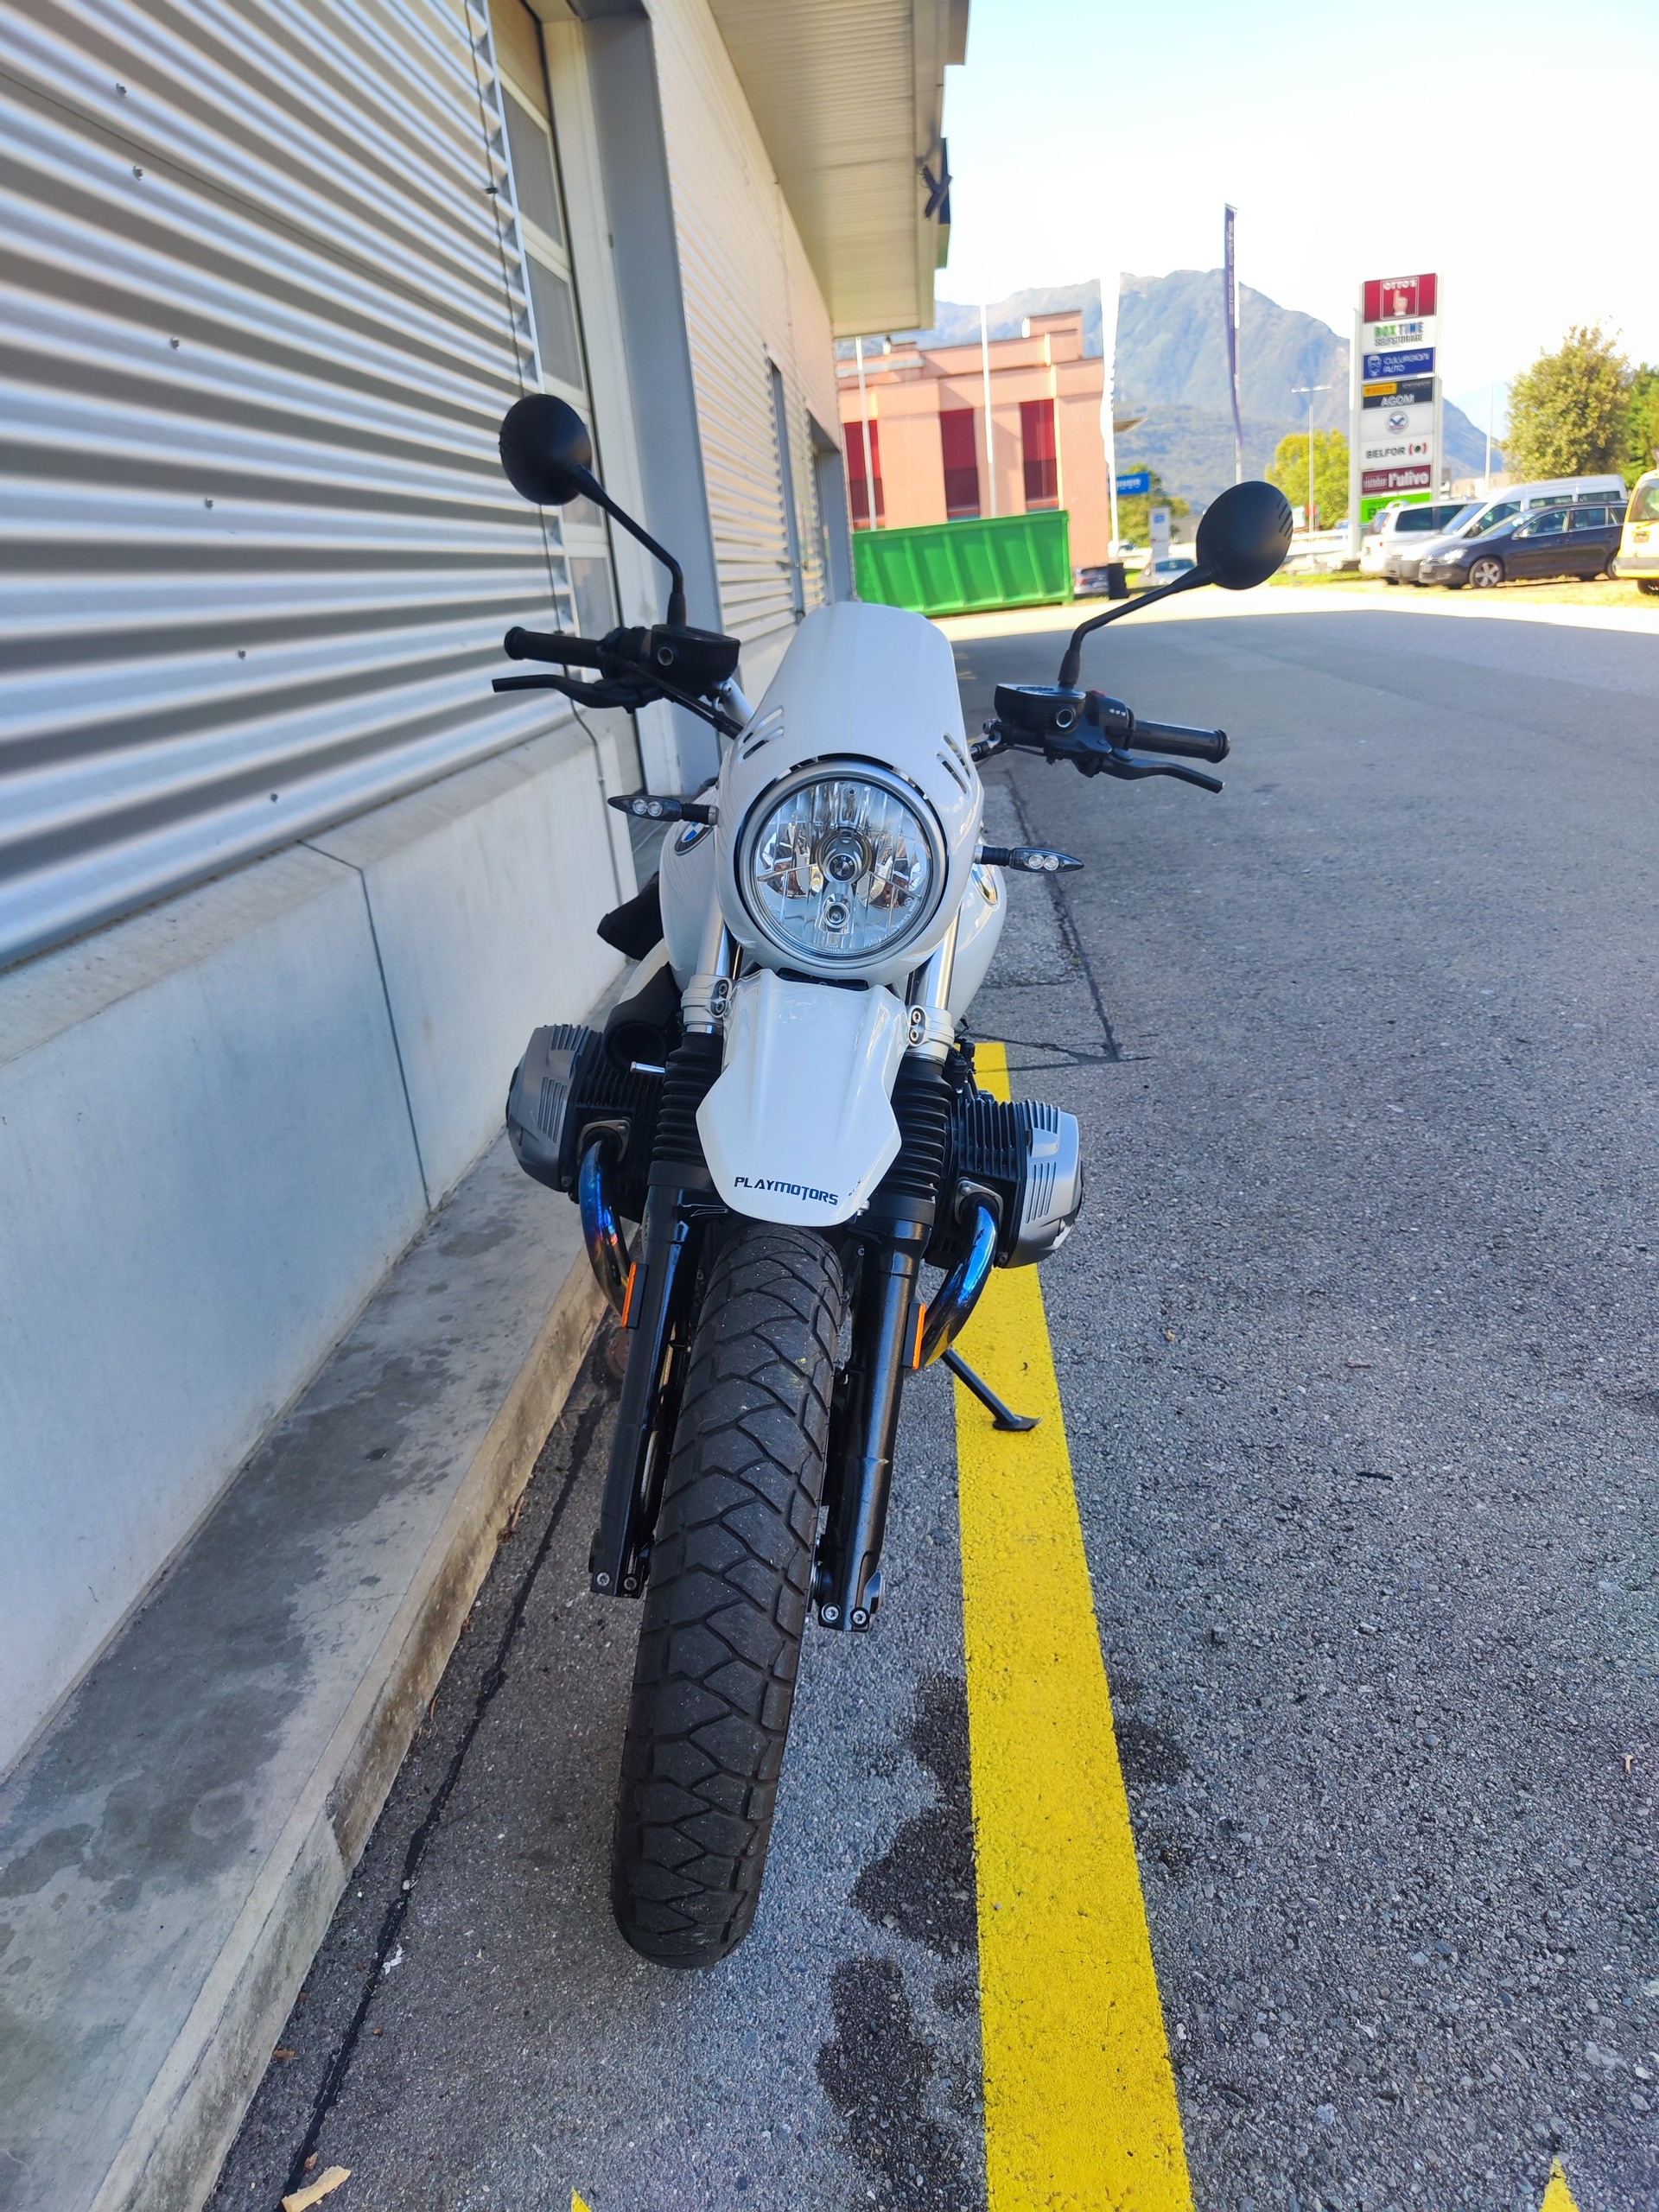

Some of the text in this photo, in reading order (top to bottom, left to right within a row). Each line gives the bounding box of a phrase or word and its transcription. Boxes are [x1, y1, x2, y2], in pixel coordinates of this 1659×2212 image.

[1383, 279, 1417, 290] OTTO'S
[1375, 322, 1424, 337] BOX TIME
[1383, 364, 1406, 373] AUTO
[1380, 394, 1415, 407] AGOM
[1365, 446, 1407, 459] BELFOR
[734, 1176, 839, 1205] PLAYMOTORS
